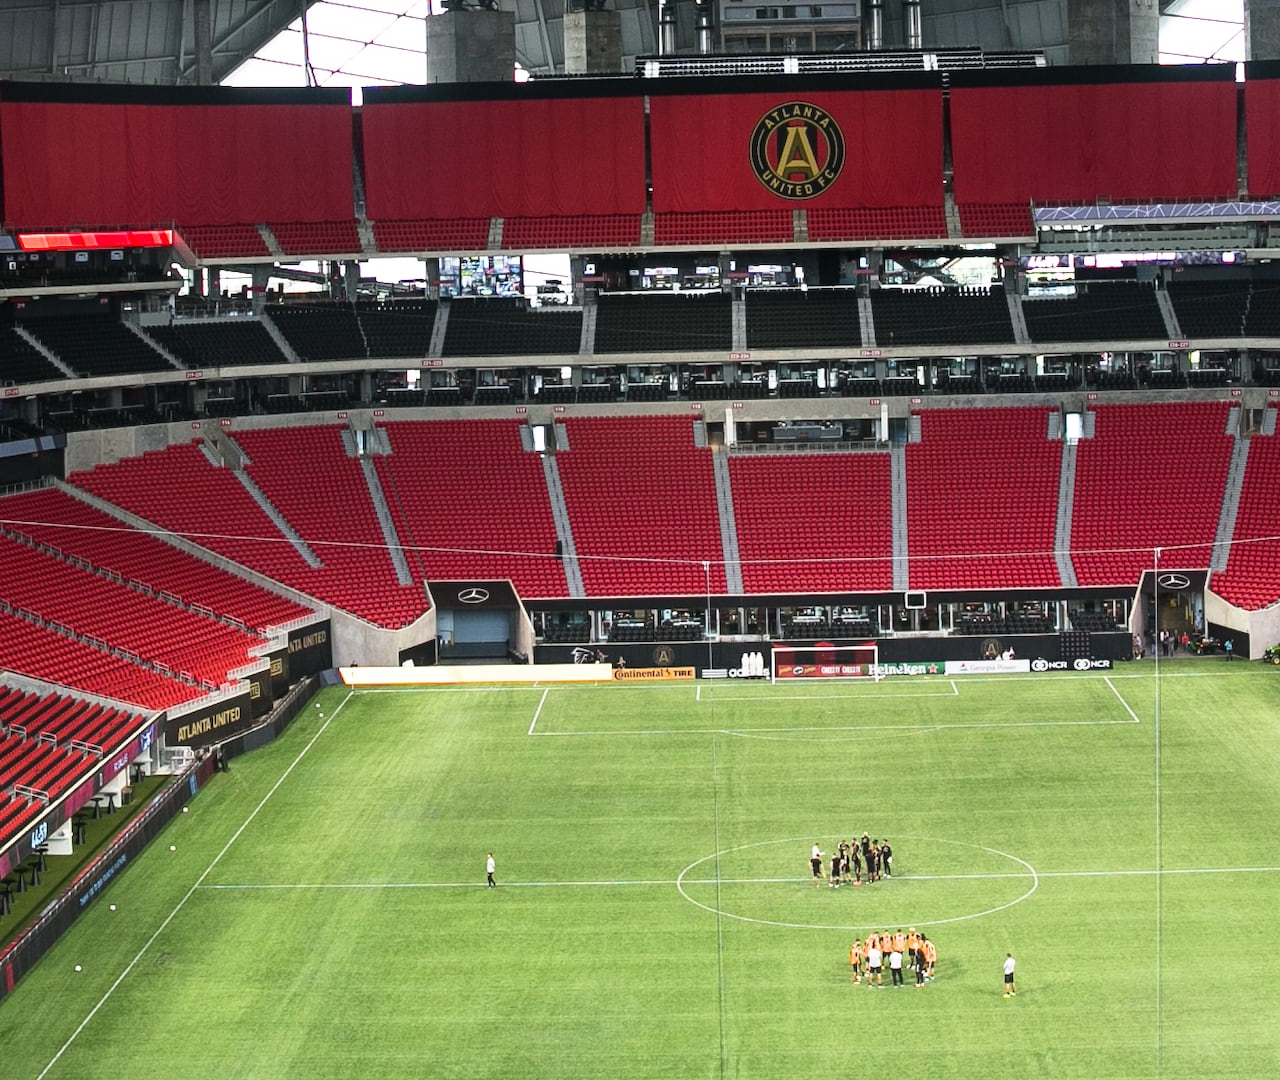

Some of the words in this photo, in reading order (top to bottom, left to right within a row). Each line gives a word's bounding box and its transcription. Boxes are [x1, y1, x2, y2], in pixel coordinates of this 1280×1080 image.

[764, 104, 830, 129] ATLANTA
[762, 170, 813, 195] UNITED
[817, 169, 835, 187] FC
[303, 630, 326, 648] UNITED
[869, 662, 927, 675] Heineken
[970, 663, 994, 672] Georgia
[996, 662, 1017, 670] Power
[1049, 661, 1068, 669] NCR
[1091, 659, 1110, 668] NCR
[614, 668, 664, 681] Continental
[674, 670, 693, 679] TIRE
[177, 718, 212, 743] ATLANTA
[212, 706, 240, 729] UNITED
